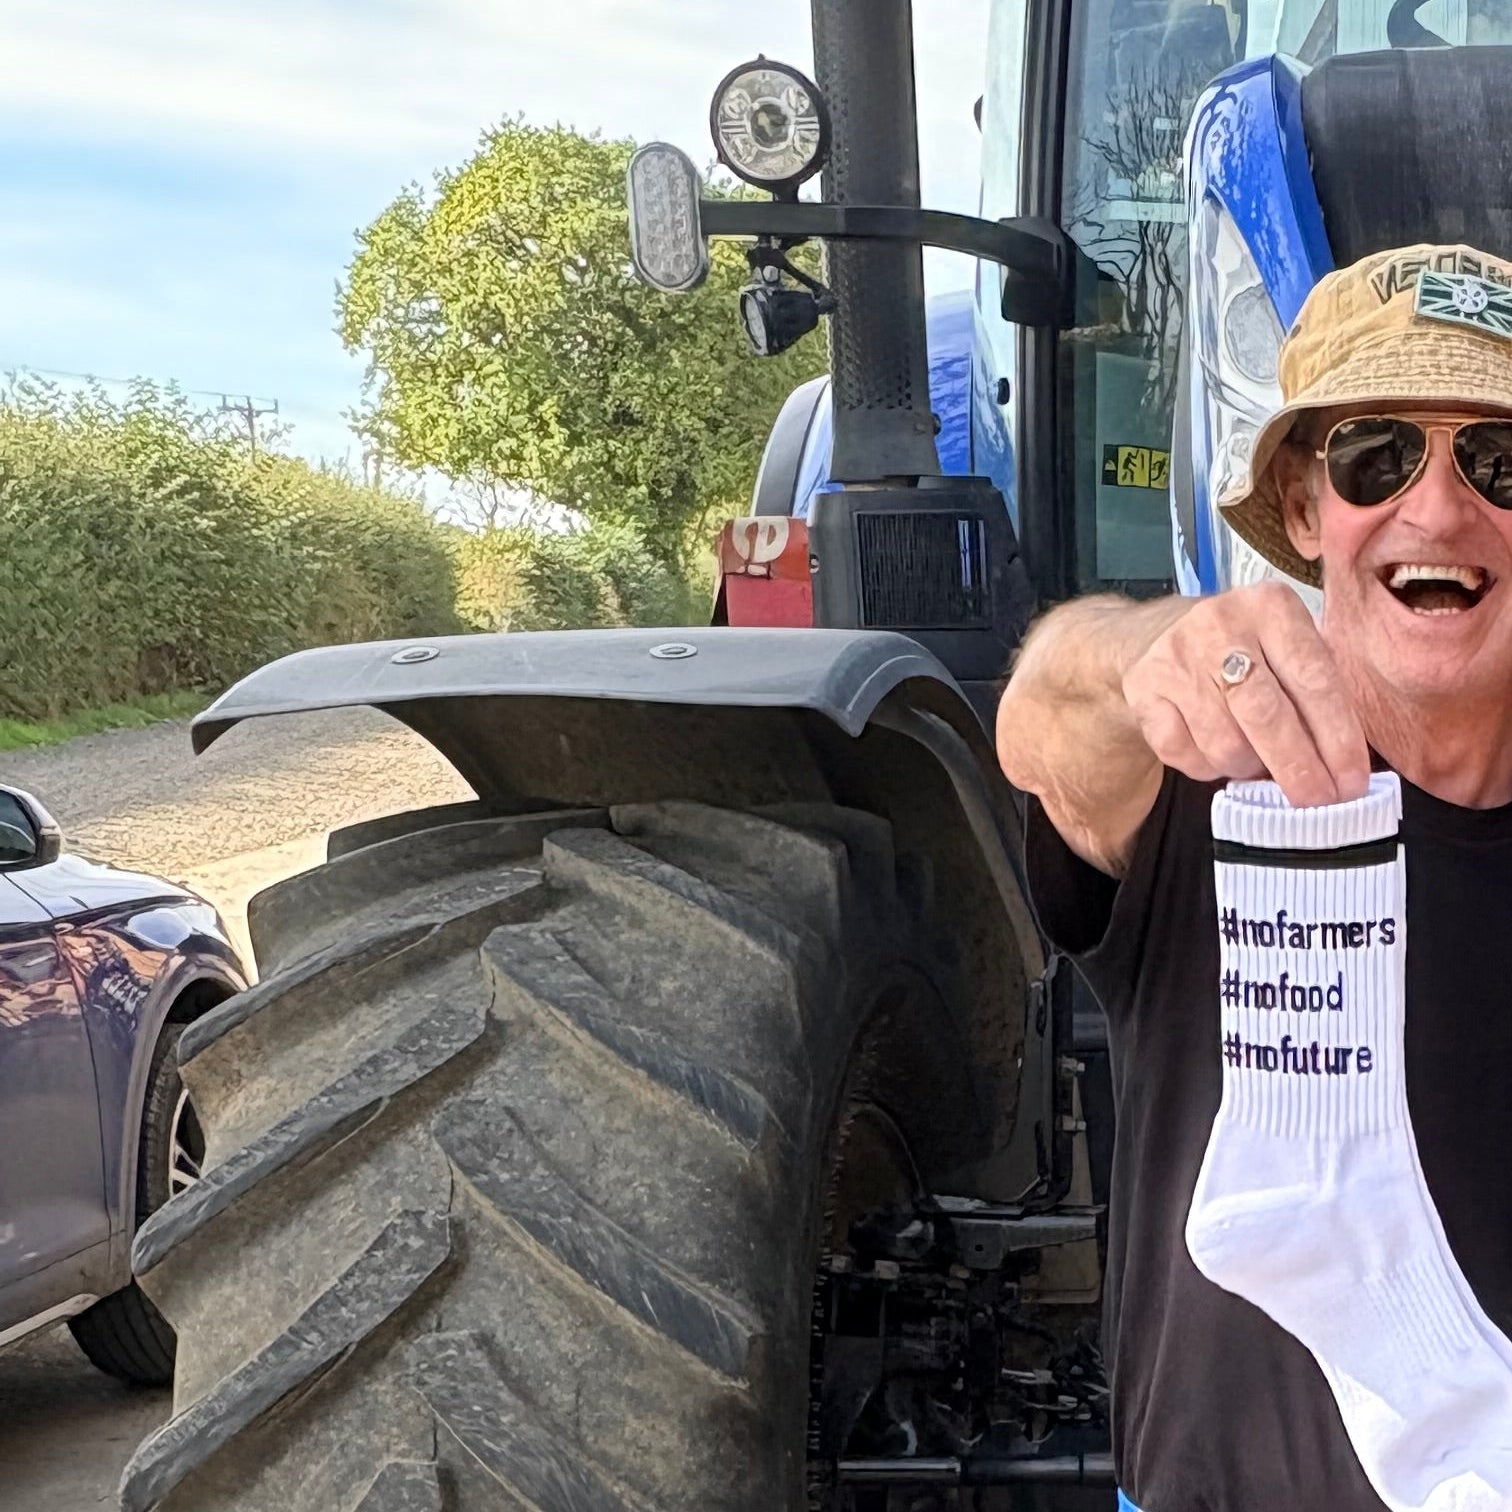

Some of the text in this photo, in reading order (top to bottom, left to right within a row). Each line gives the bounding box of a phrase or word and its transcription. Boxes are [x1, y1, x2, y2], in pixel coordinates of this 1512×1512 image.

[1220, 906, 1396, 950] #nofarmers
[1221, 968, 1343, 1013] #nofood
[1223, 1030, 1373, 1076] #nofuture
